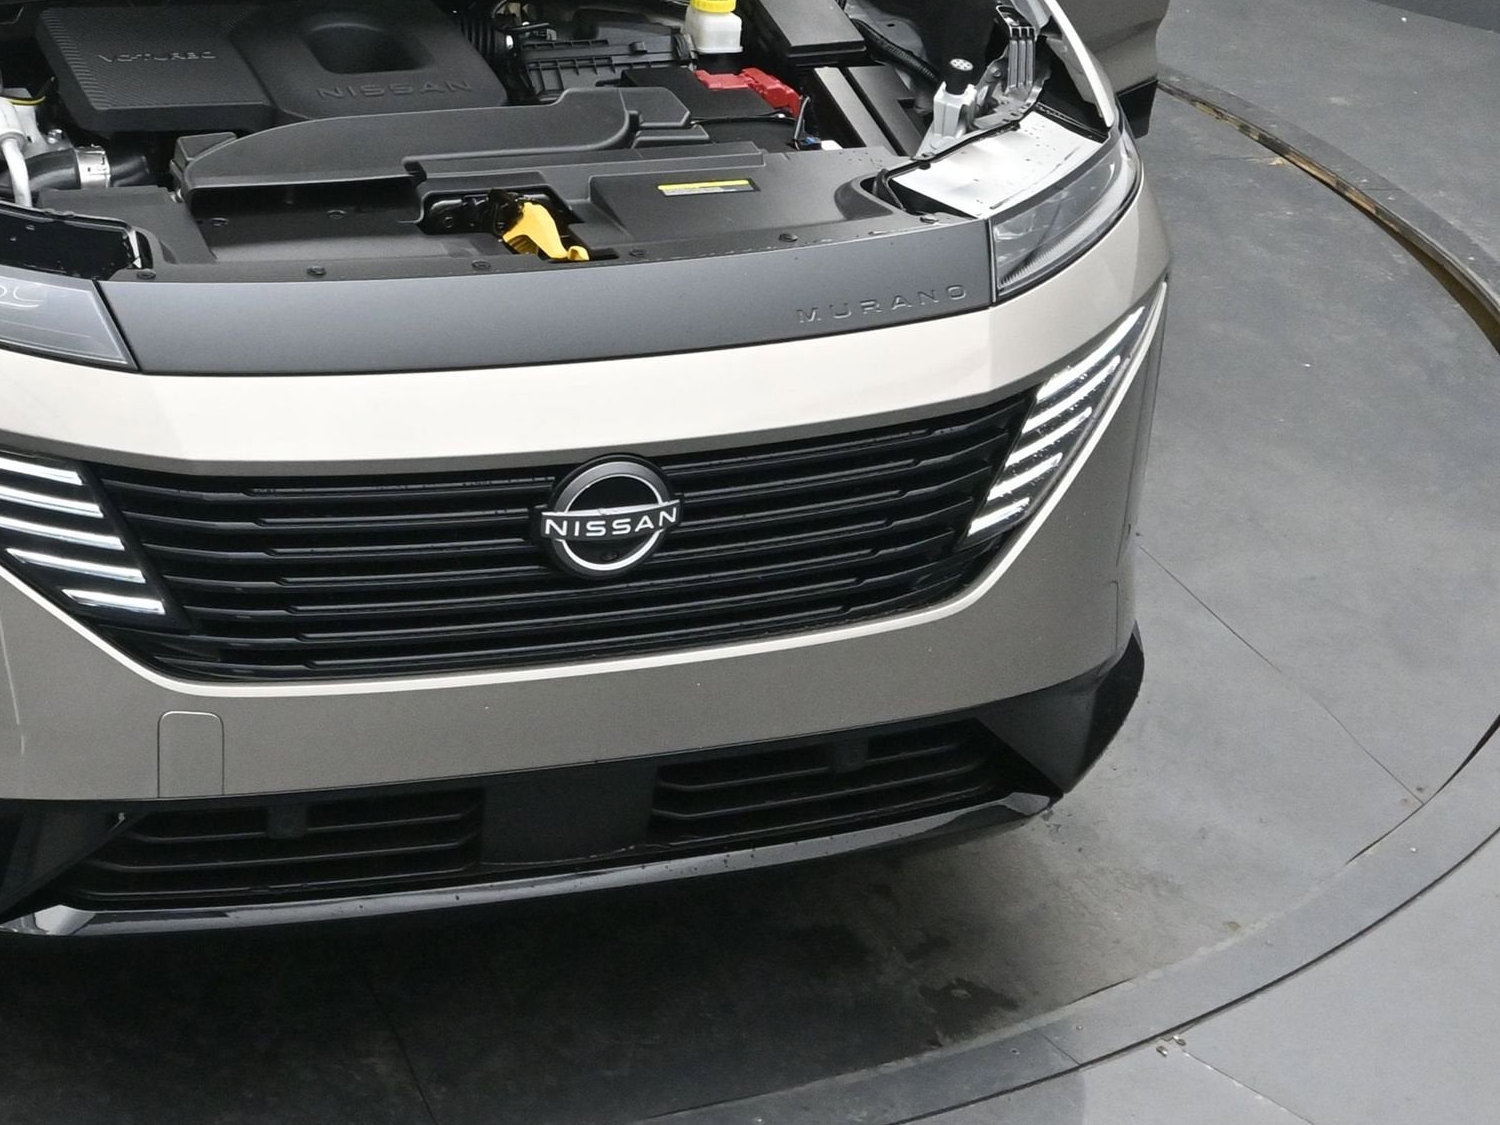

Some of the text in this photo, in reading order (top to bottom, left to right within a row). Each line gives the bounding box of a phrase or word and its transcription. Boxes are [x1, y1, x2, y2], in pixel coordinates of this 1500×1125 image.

[316, 80, 474, 100] NISSAN
[796, 284, 968, 324] MURANO
[545, 506, 678, 537] NISSAN
